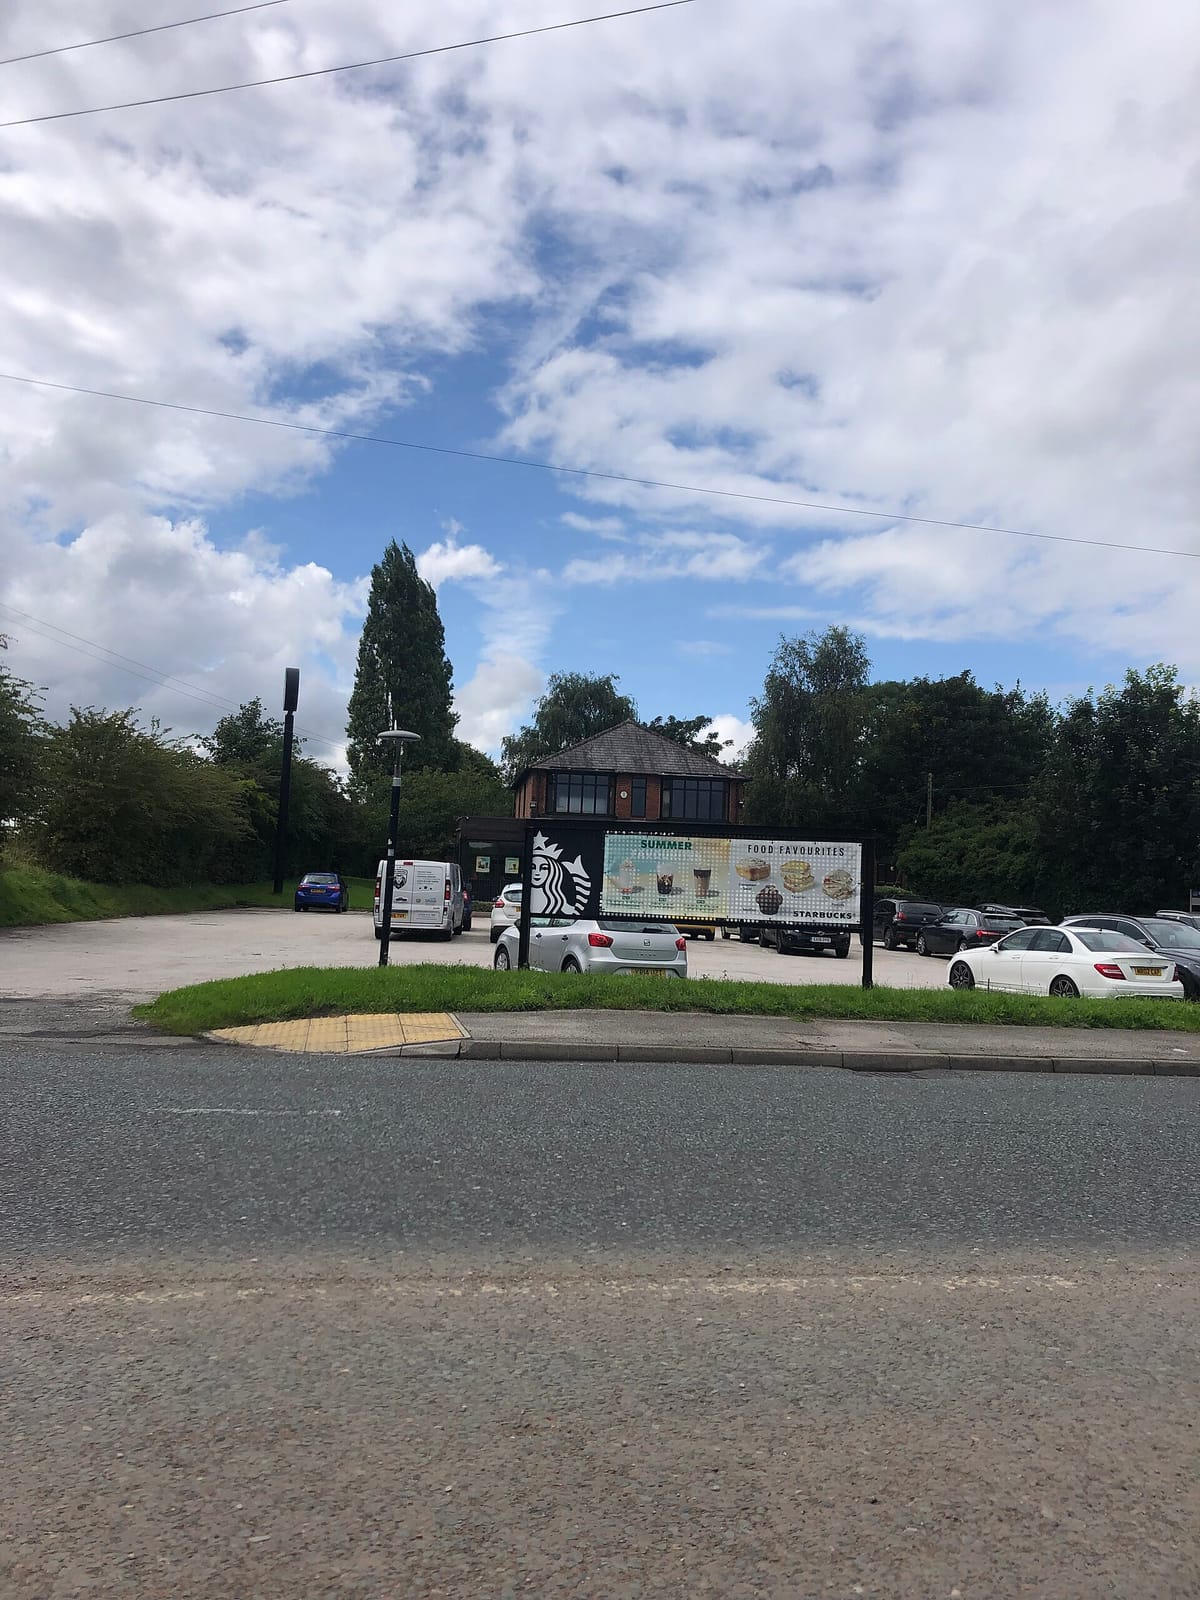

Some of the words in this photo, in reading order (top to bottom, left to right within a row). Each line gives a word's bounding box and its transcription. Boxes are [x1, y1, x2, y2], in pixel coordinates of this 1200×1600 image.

[640, 840, 692, 851] SUMMER
[747, 844, 773, 854] FOOD
[779, 845, 845, 857] FAVOURITES
[793, 910, 853, 919] STARBUCKS
